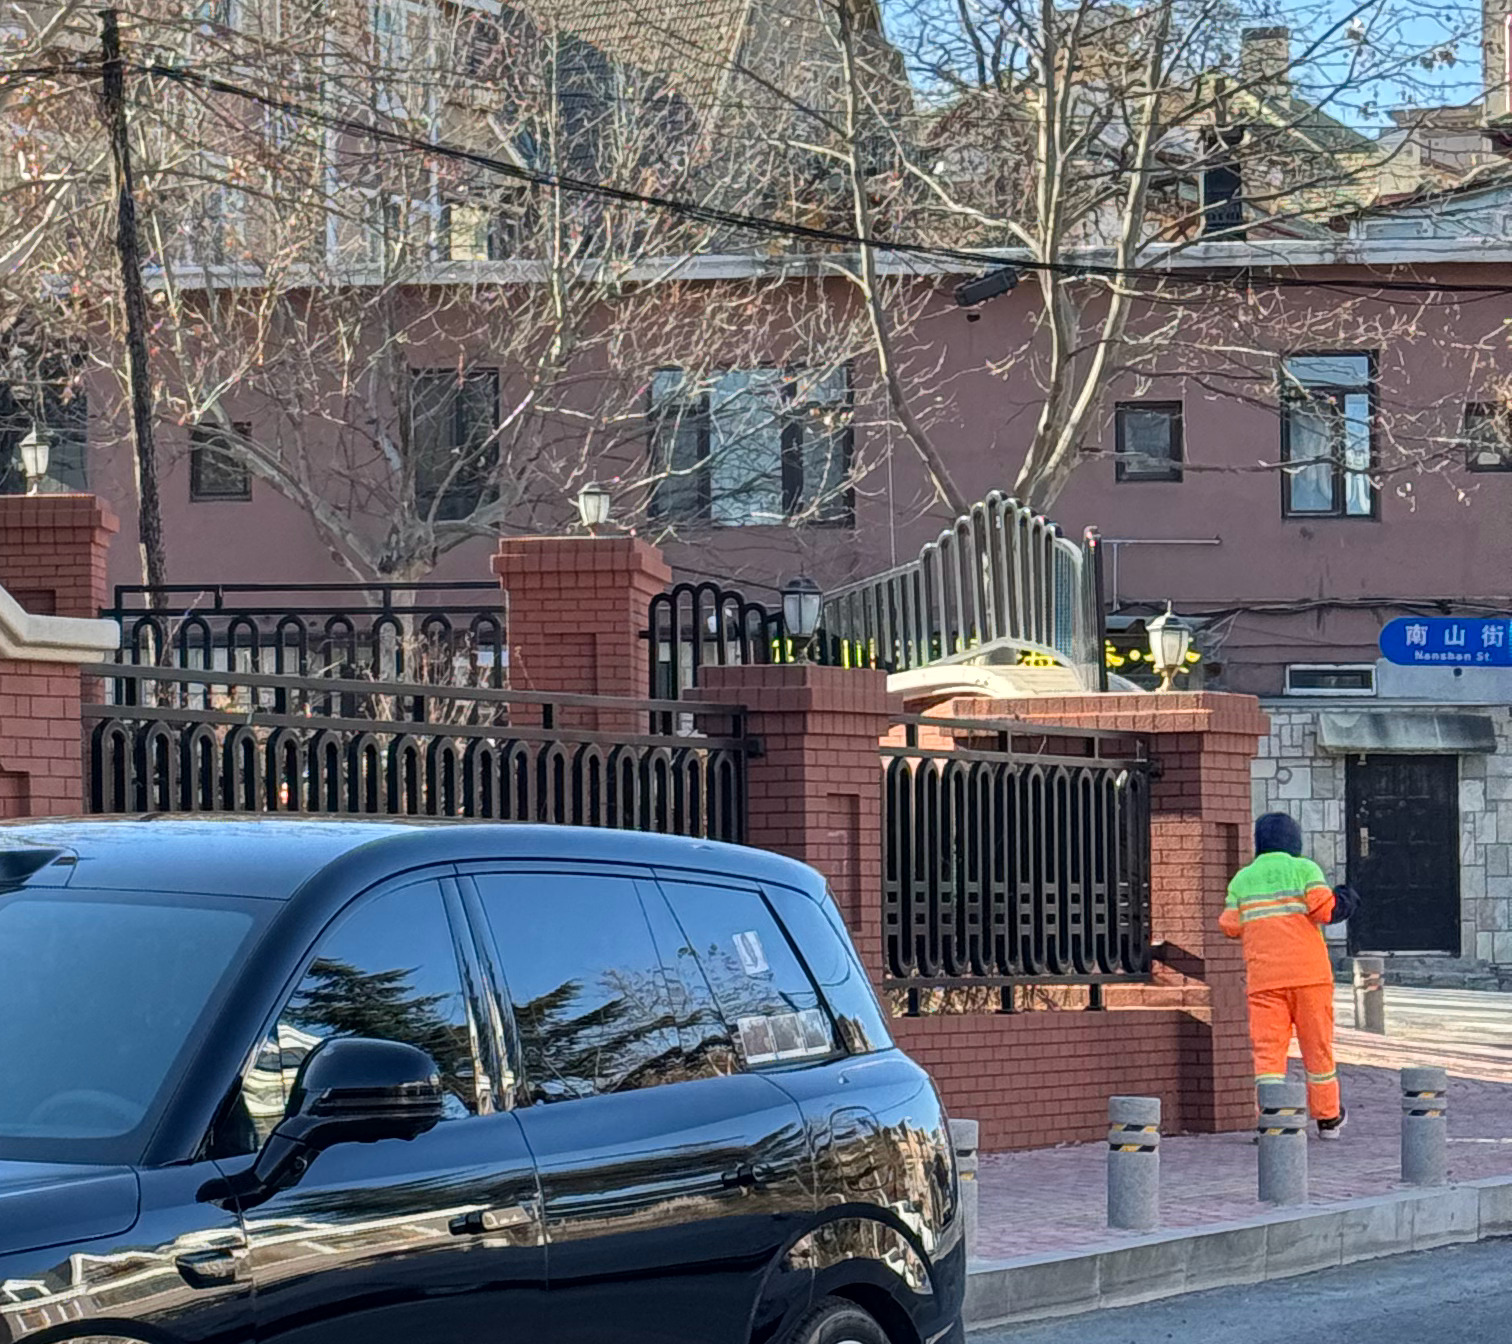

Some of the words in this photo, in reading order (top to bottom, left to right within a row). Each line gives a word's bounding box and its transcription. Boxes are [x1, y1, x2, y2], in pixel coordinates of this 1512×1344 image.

[1405, 623, 1505, 648] 南山街
[1414, 649, 1472, 661] Nanshan
